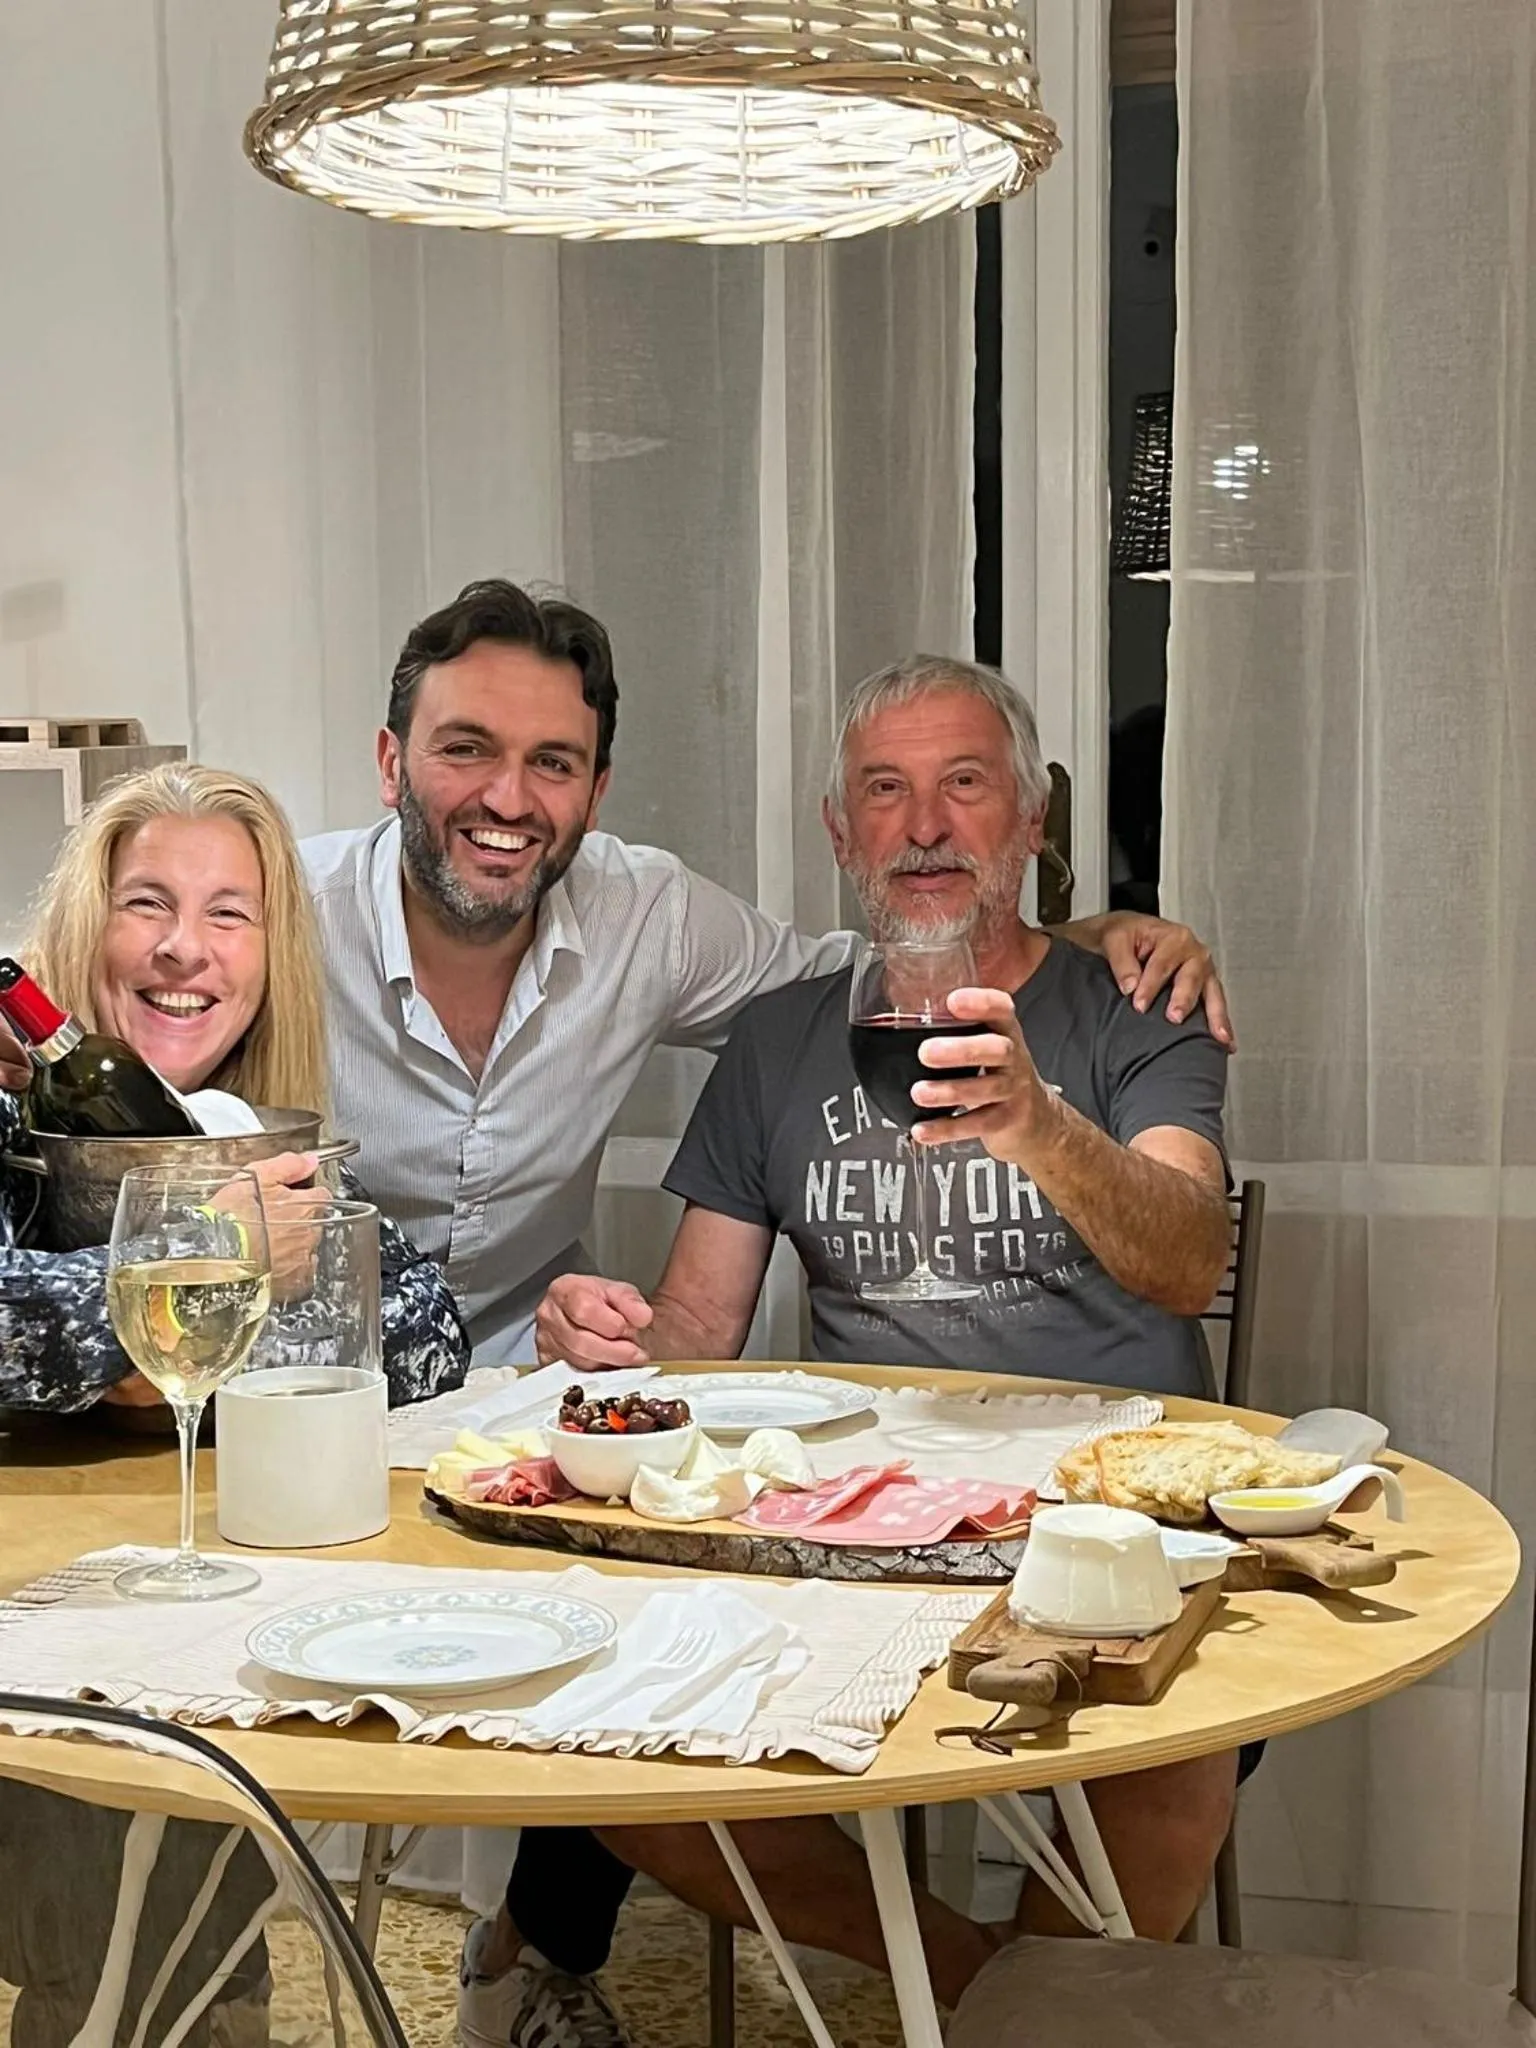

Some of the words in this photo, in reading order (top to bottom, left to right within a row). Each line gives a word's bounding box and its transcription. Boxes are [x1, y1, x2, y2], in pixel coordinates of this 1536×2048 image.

[806, 1159, 906, 1224] NEW
[932, 1157, 1063, 1227] YOR
[974, 1228, 1026, 1275] ED
